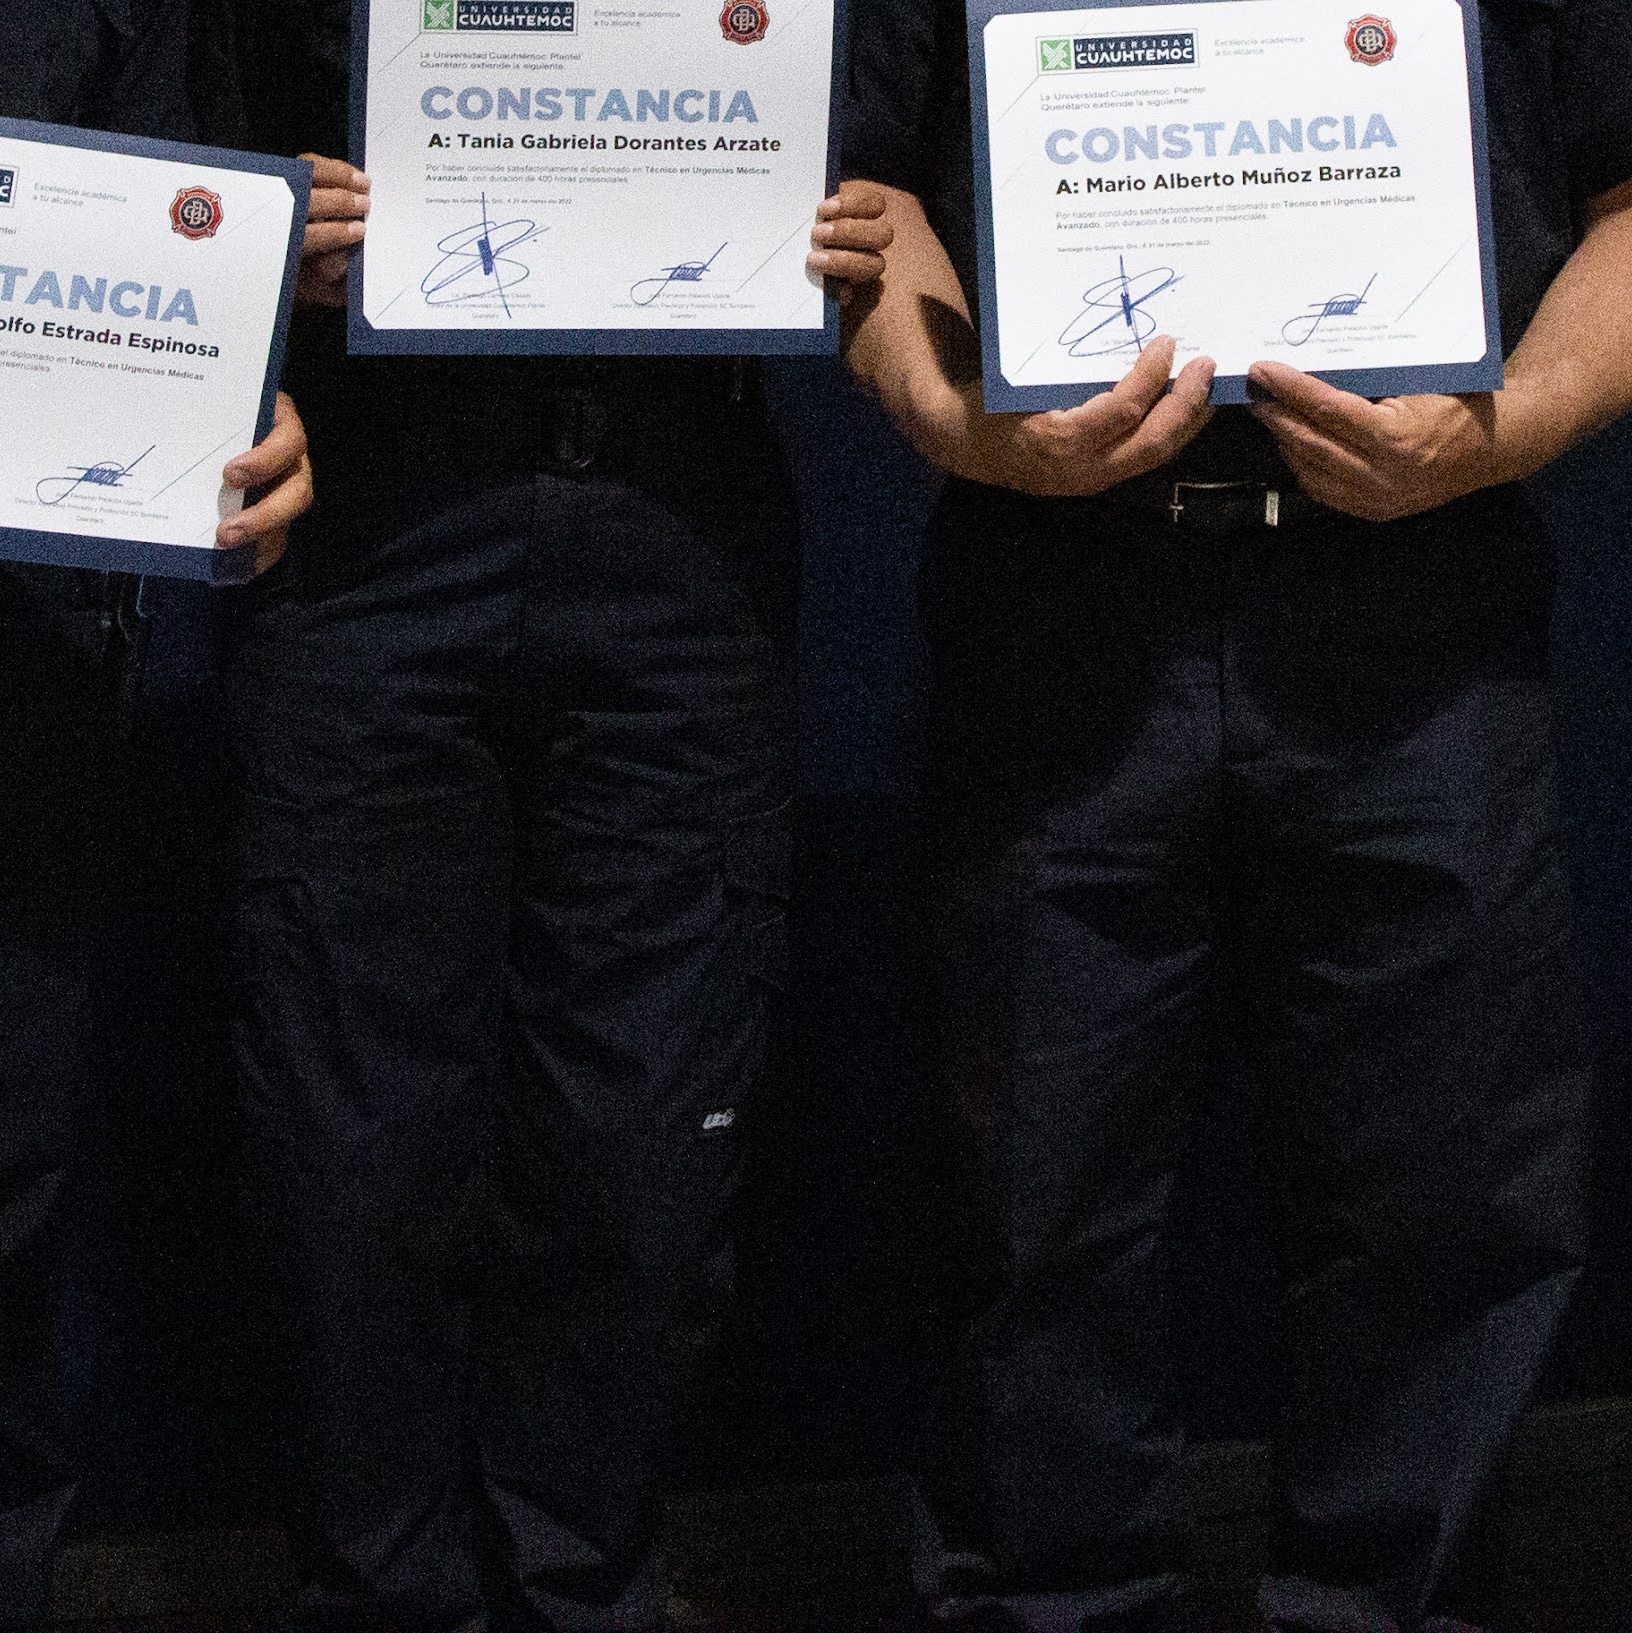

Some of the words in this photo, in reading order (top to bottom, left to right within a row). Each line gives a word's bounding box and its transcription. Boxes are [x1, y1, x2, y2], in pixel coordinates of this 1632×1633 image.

[459, 5, 572, 14] UNIVERSIDAD
[458, 14, 572, 26] CUAUHTEMOC
[1075, 37, 1191, 52] UNIVERSIDAD
[433, 51, 487, 59] Universidad
[489, 51, 546, 60] Cuauhtémoc
[550, 52, 581, 60] Plantel
[1076, 46, 1193, 65] CUAUHTEMOC
[419, 61, 467, 70] Querétaro
[470, 61, 510, 70] extiende
[1055, 89, 1109, 101] Universidad
[1110, 86, 1170, 98] Cuauhtémoc
[1173, 84, 1206, 94] Plantel
[420, 85, 759, 123] CONSTANCIA
[1040, 101, 1089, 113] Querétaro
[1092, 99, 1133, 110] extiende
[428, 133, 450, 147] A:
[457, 133, 513, 148] Tania
[520, 133, 606, 149] Gabriela
[614, 135, 706, 150] Dorantes
[713, 136, 780, 151] Arzate
[1045, 113, 1397, 164] CONSTANCIA
[645, 165, 677, 174] Técnico
[692, 166, 733, 174] Urgencias
[736, 166, 770, 174] Médicas
[537, 174, 552, 182] 400
[554, 175, 576, 183] horas
[1056, 179, 1078, 194] A:
[1086, 175, 1145, 192] Mario
[1153, 172, 1234, 189] Alberto
[1242, 167, 1311, 185] Muñoz
[1319, 166, 1400, 181] Barraza
[1283, 198, 1317, 208] Técnico
[1333, 195, 1377, 206] Urgencias
[1379, 193, 1415, 203] Médicas
[1172, 215, 1187, 224] 400
[1190, 214, 1212, 223] horas
[42, 321, 121, 345] Estrada
[128, 332, 219, 357] Espinosa
[70, 357, 105, 369] Técnico
[120, 363, 165, 376] Urgencias
[167, 369, 204, 381] Médicas
